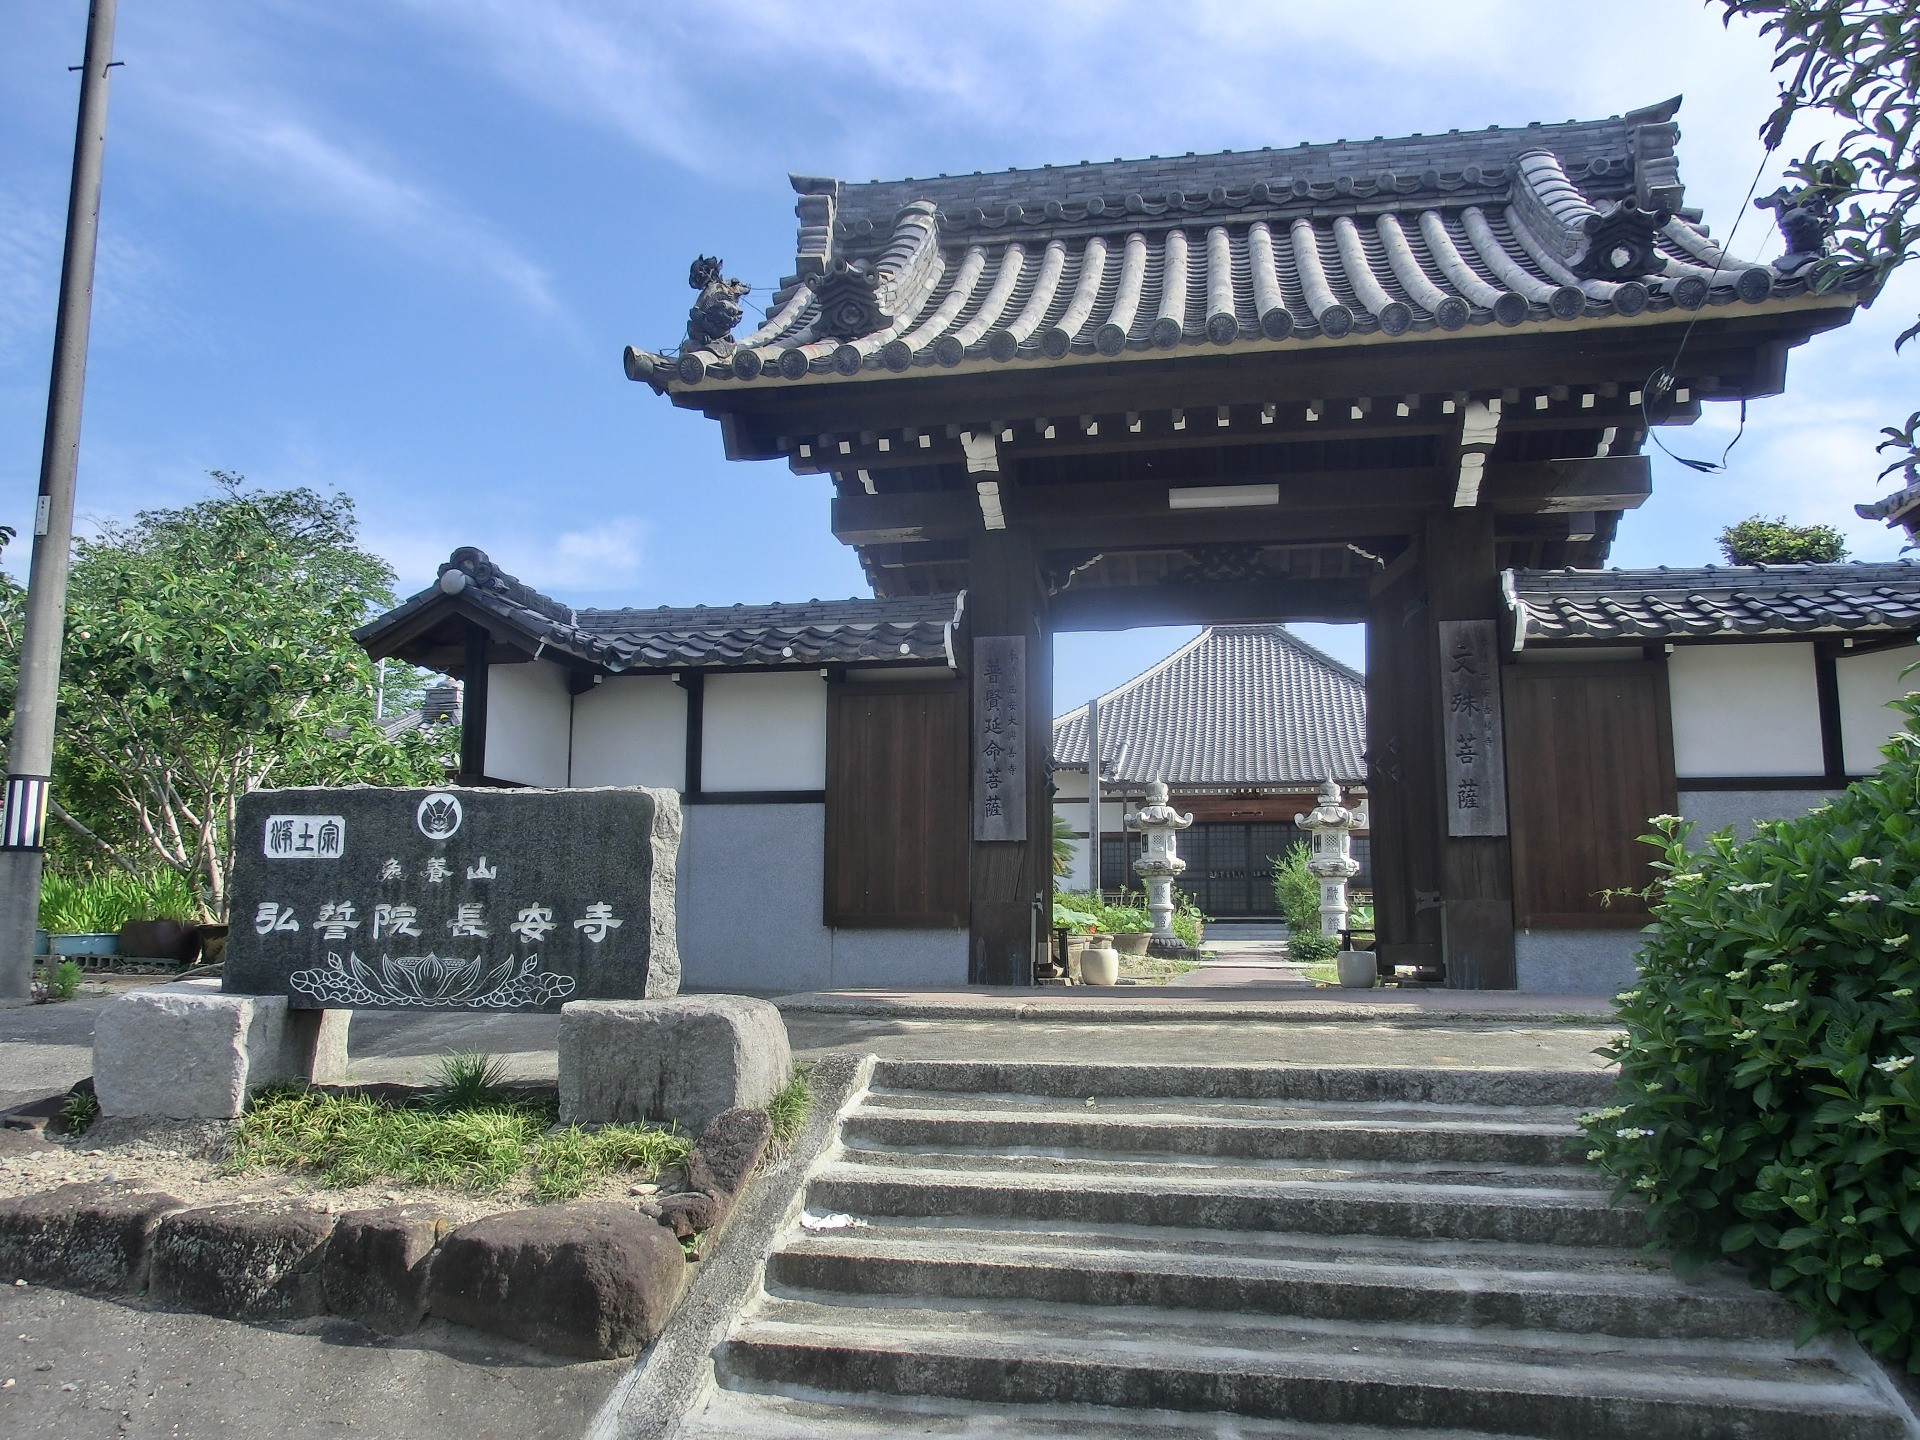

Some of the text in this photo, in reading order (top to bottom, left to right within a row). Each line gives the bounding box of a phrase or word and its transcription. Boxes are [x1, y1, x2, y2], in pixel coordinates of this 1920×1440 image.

[983, 660, 1005, 818] 普賢延命菩薩
[1451, 646, 1480, 809] 文殊菩薩
[256, 901, 624, 943] 弘誓院長安寺
